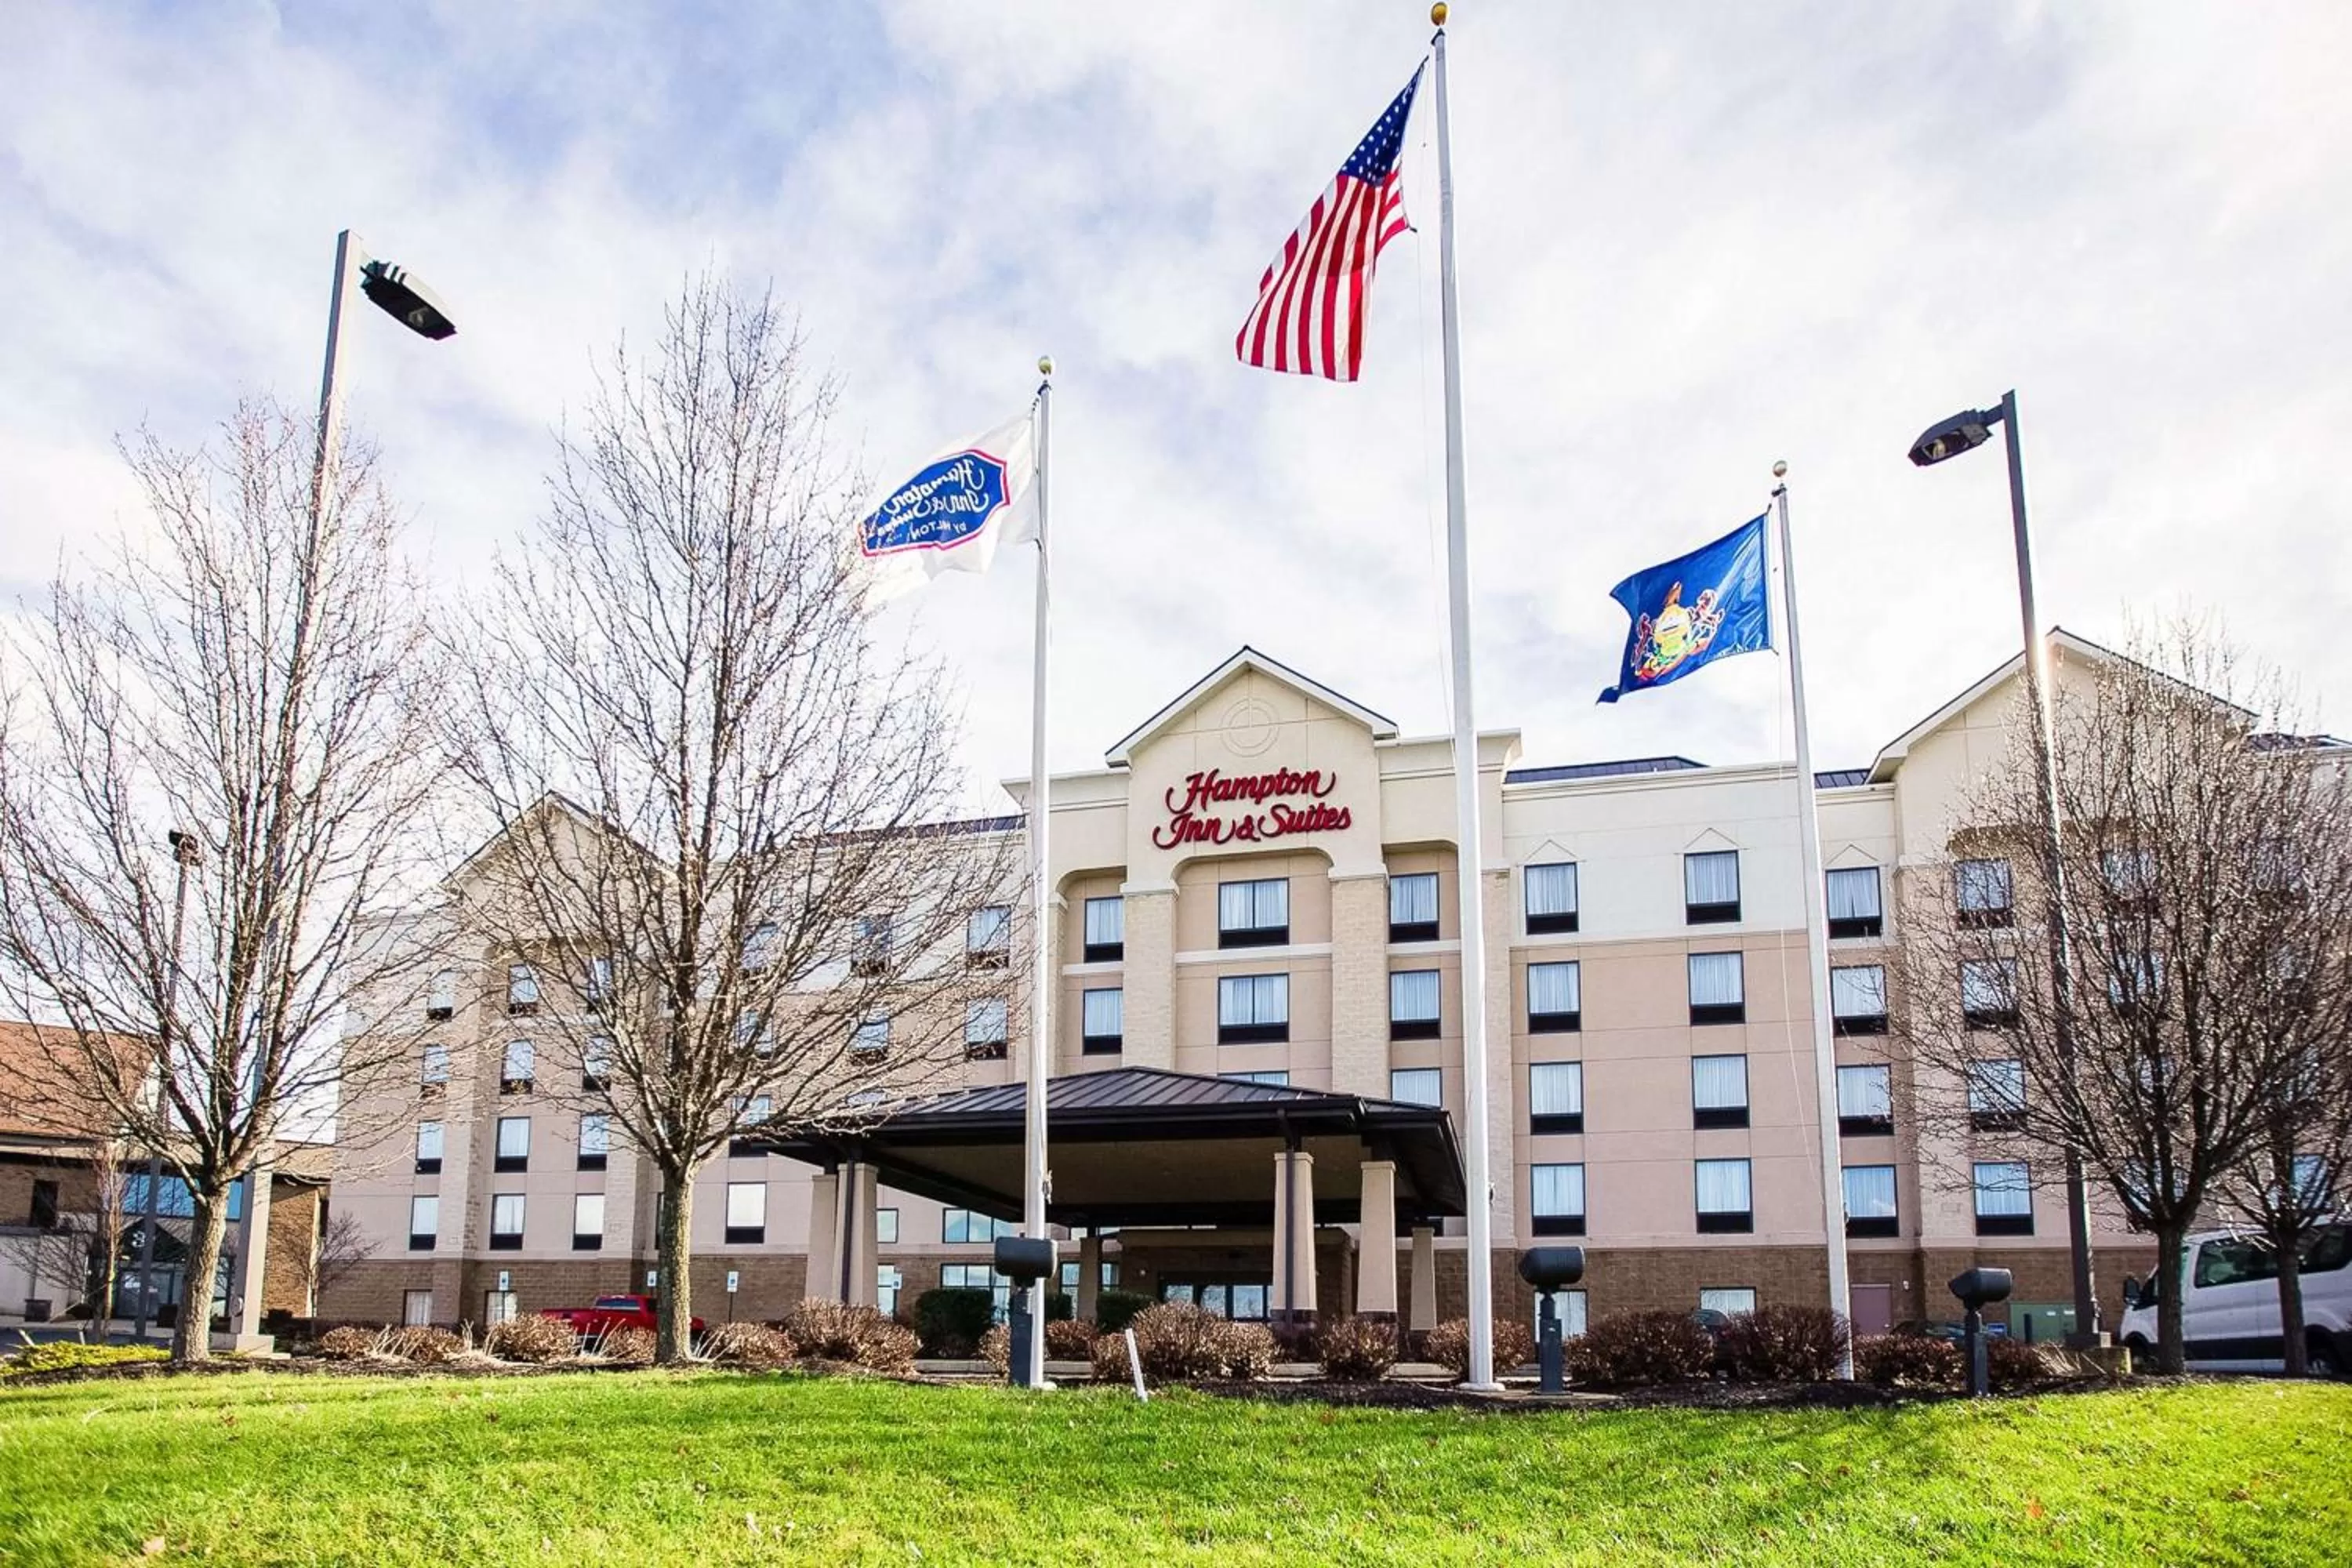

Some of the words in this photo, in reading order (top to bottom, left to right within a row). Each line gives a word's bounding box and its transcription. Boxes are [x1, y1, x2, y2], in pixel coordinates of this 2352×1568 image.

[1165, 767, 1337, 814] Hampton
[1152, 812, 1237, 851] Inn
[1235, 814, 1261, 842] &
[1257, 801, 1352, 838] Suites
